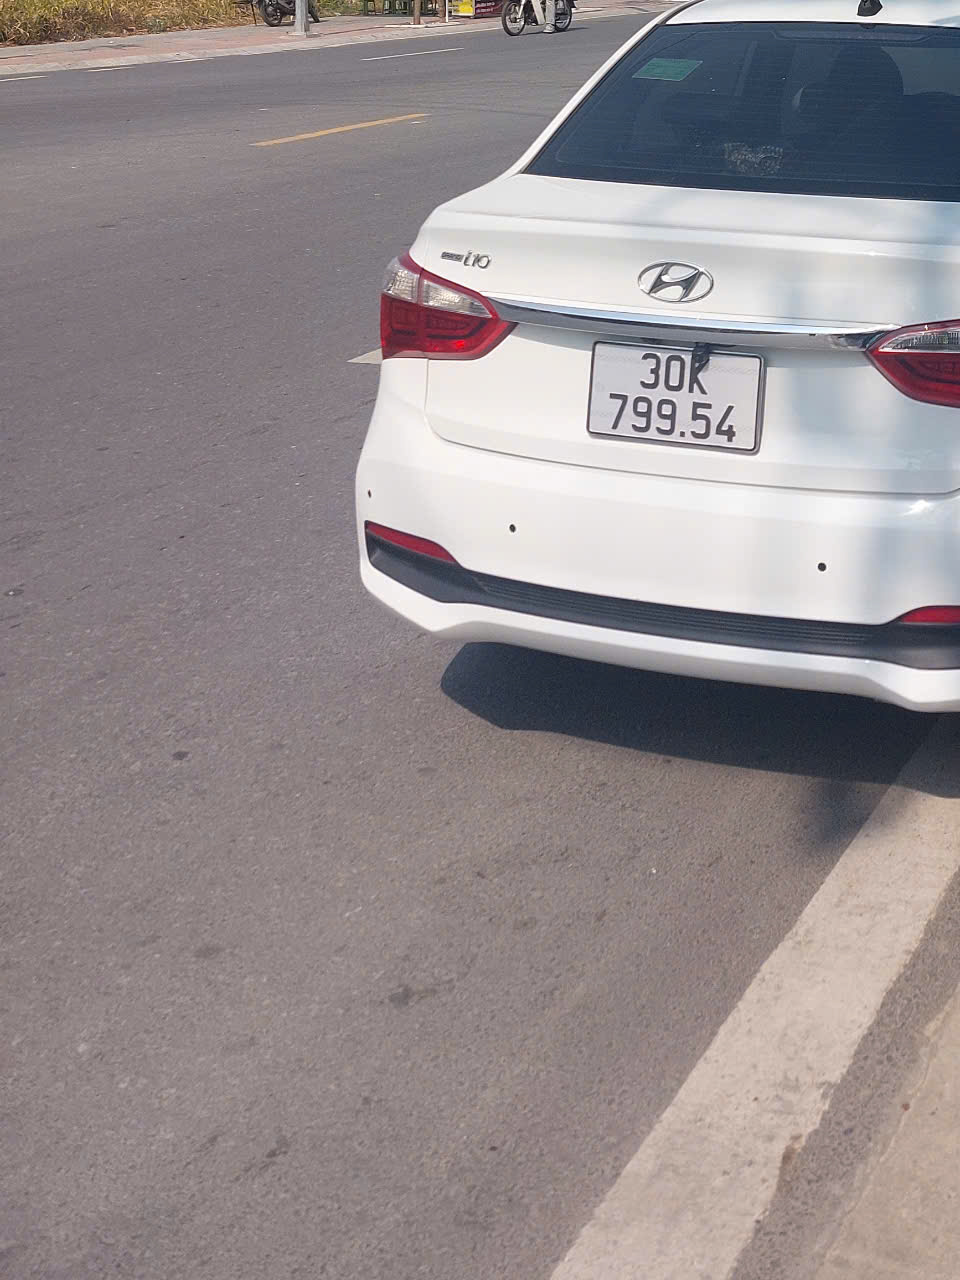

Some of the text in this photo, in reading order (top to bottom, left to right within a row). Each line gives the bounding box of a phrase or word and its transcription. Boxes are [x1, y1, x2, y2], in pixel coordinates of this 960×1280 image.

[463, 250, 492, 269] i10
[640, 352, 708, 395] 30K
[609, 393, 736, 442] 799.54
